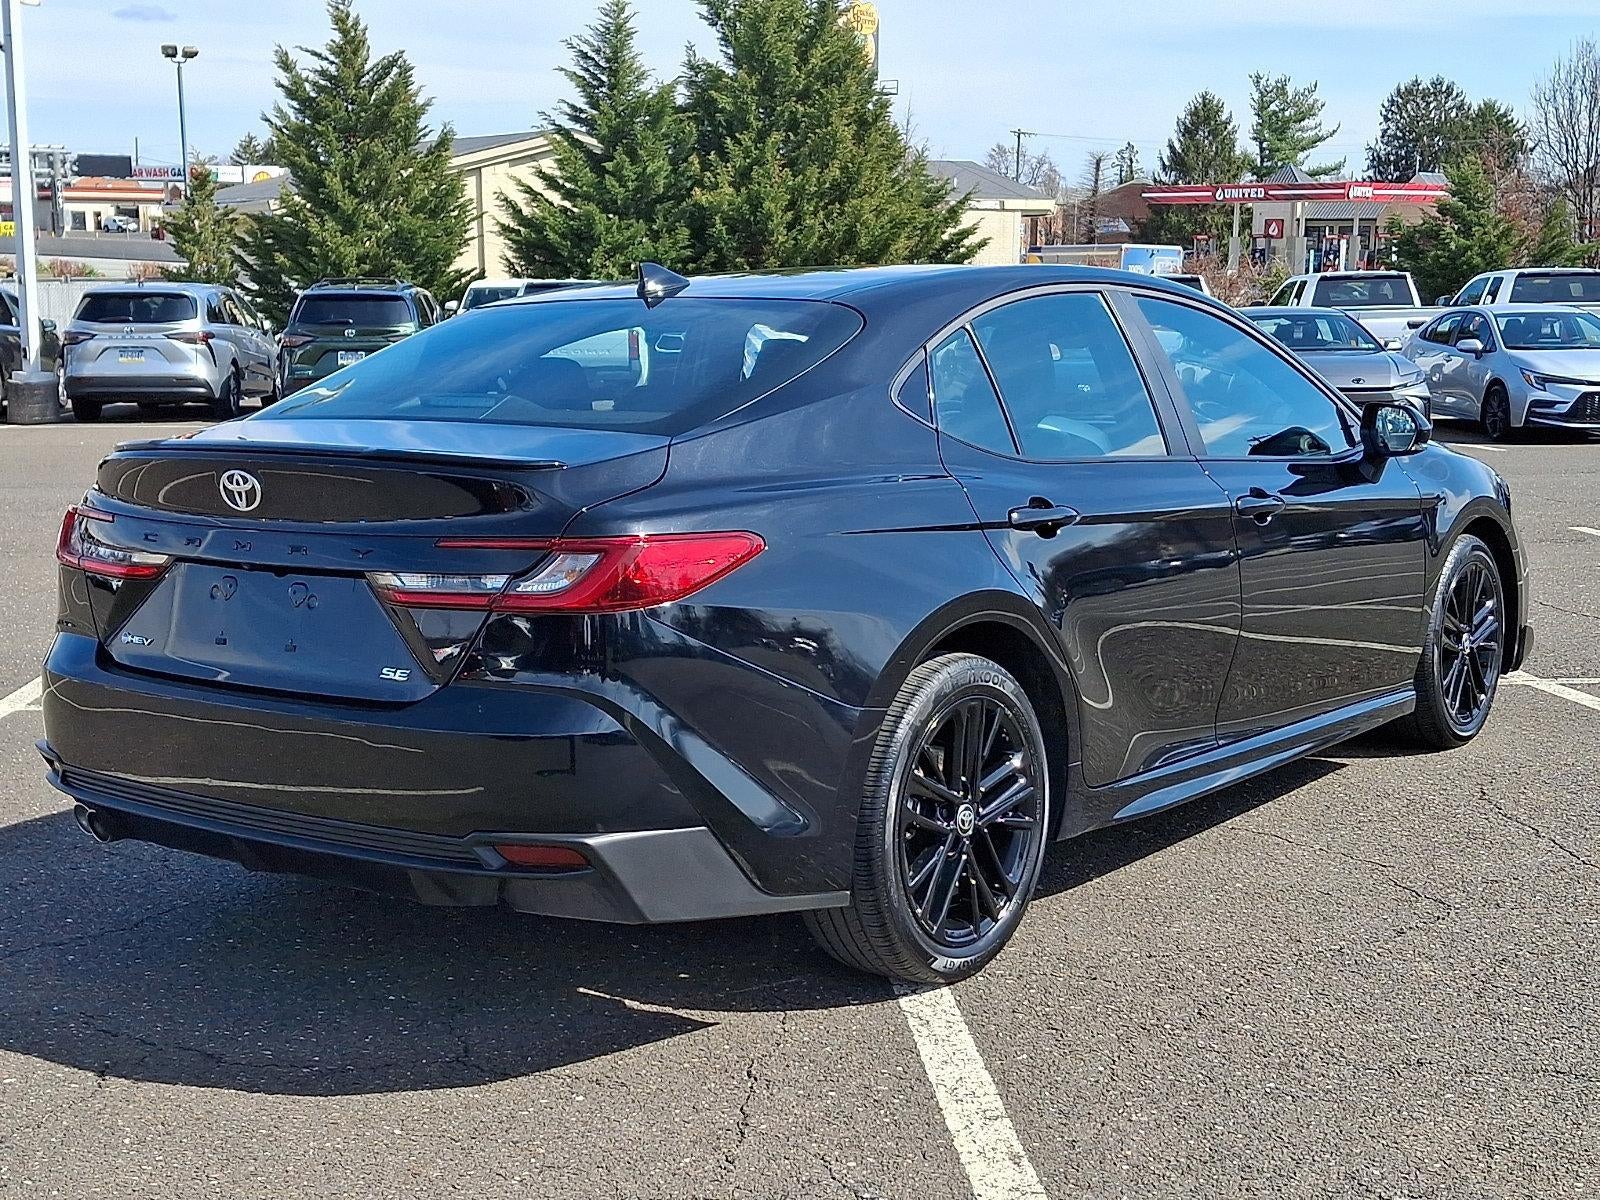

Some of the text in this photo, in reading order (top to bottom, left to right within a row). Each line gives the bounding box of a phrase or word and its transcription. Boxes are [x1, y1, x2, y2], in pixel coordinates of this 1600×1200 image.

[131, 168, 143, 178] AR
[145, 167, 168, 178] WASH
[1224, 187, 1265, 198] UNITED
[143, 532, 374, 559] CAMRY
[379, 667, 411, 681] SE
